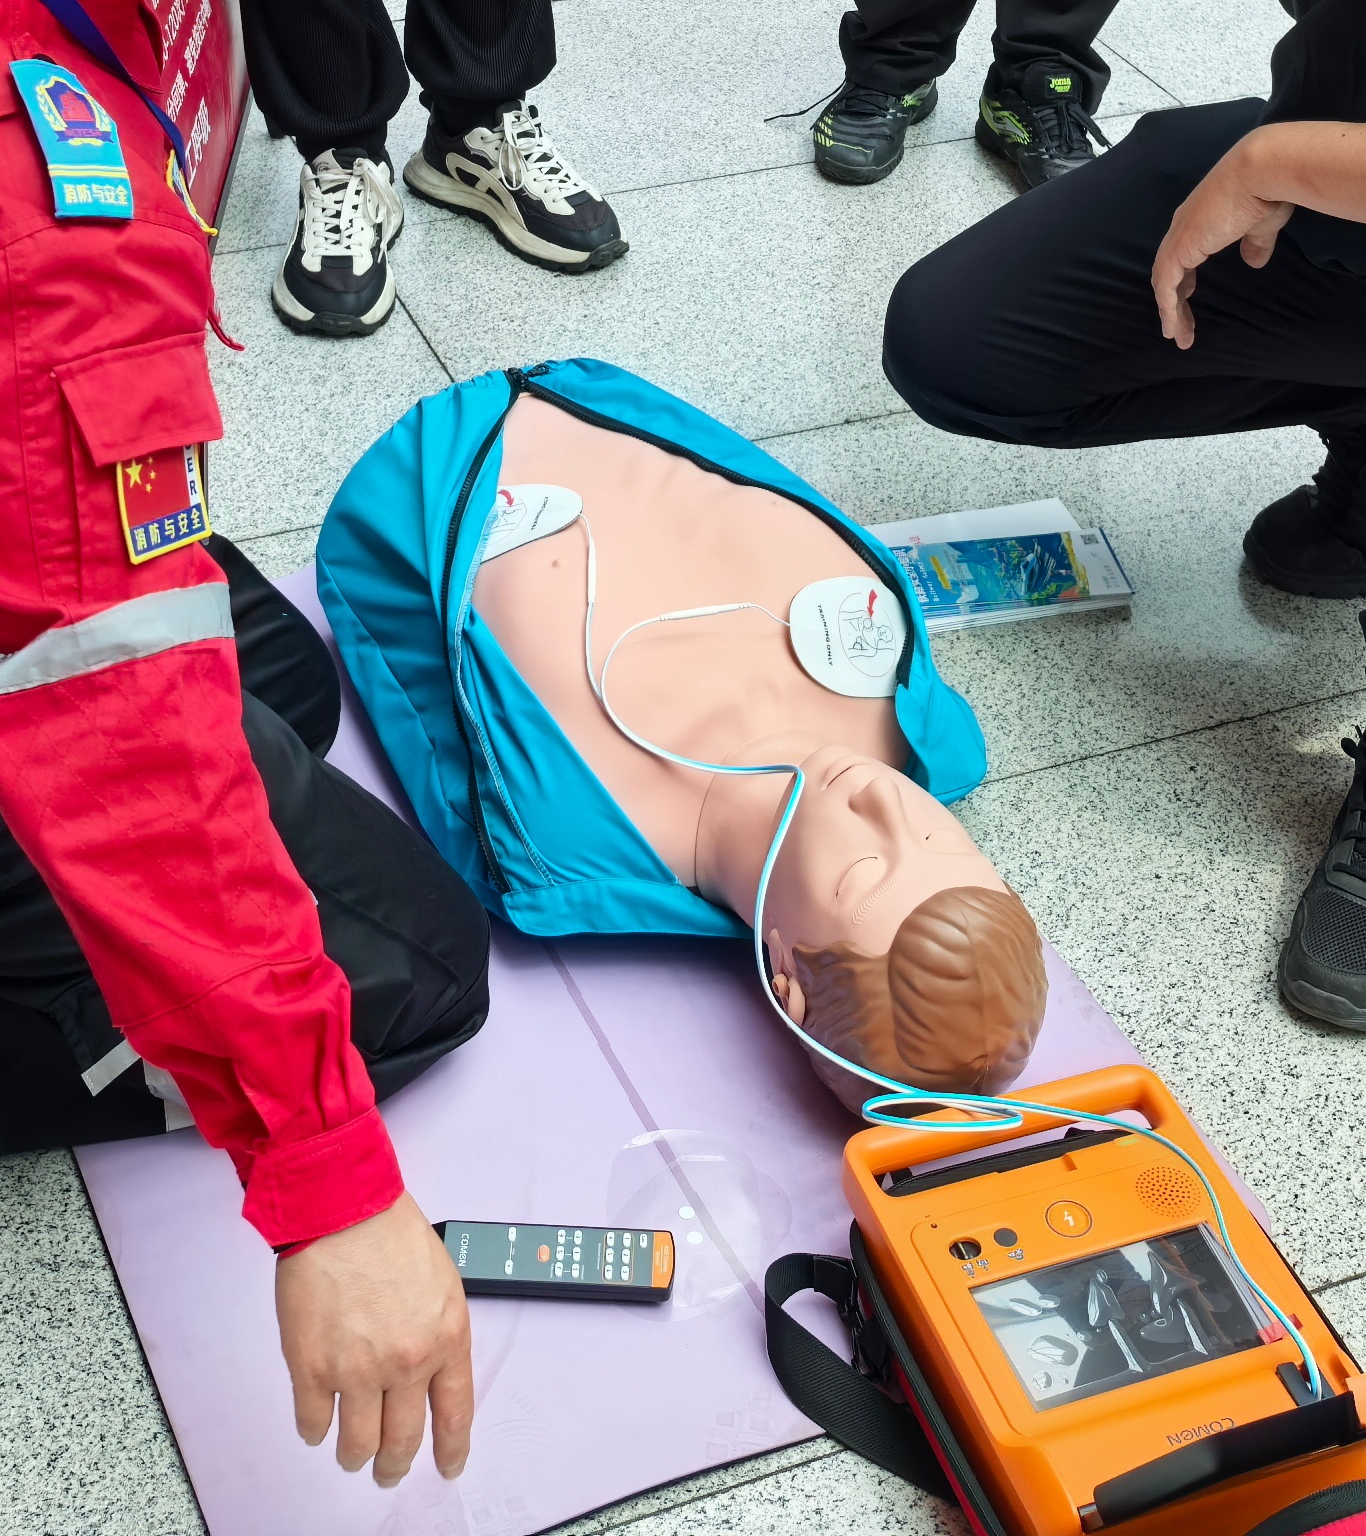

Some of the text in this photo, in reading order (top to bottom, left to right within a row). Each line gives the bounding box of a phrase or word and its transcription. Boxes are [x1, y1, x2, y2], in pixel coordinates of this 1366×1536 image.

[63, 183, 129, 206] 消防与安全
[134, 507, 202, 550] 消防与安全
[816, 604, 834, 667] TRAINING ONLY
